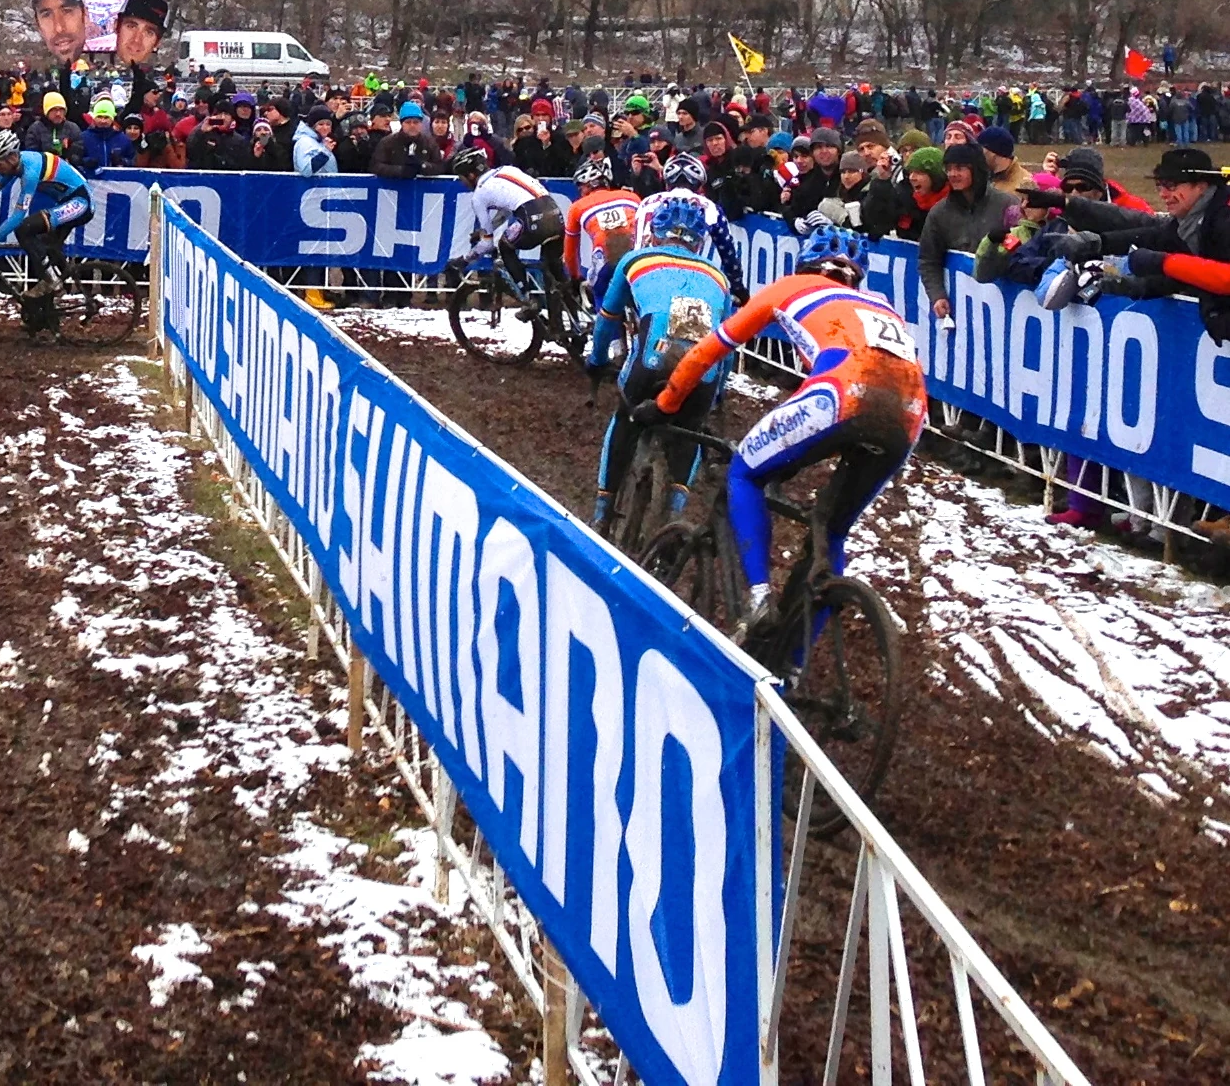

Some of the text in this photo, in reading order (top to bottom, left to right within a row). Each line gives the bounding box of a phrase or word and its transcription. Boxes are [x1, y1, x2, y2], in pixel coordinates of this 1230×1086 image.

[219, 46, 245, 54] TIME
[602, 209, 622, 225] 20
[872, 315, 906, 346] 21
[221, 271, 341, 552] SHIMANO
[745, 404, 812, 457] Rabobank
[338, 385, 727, 1086] SHIMANO
